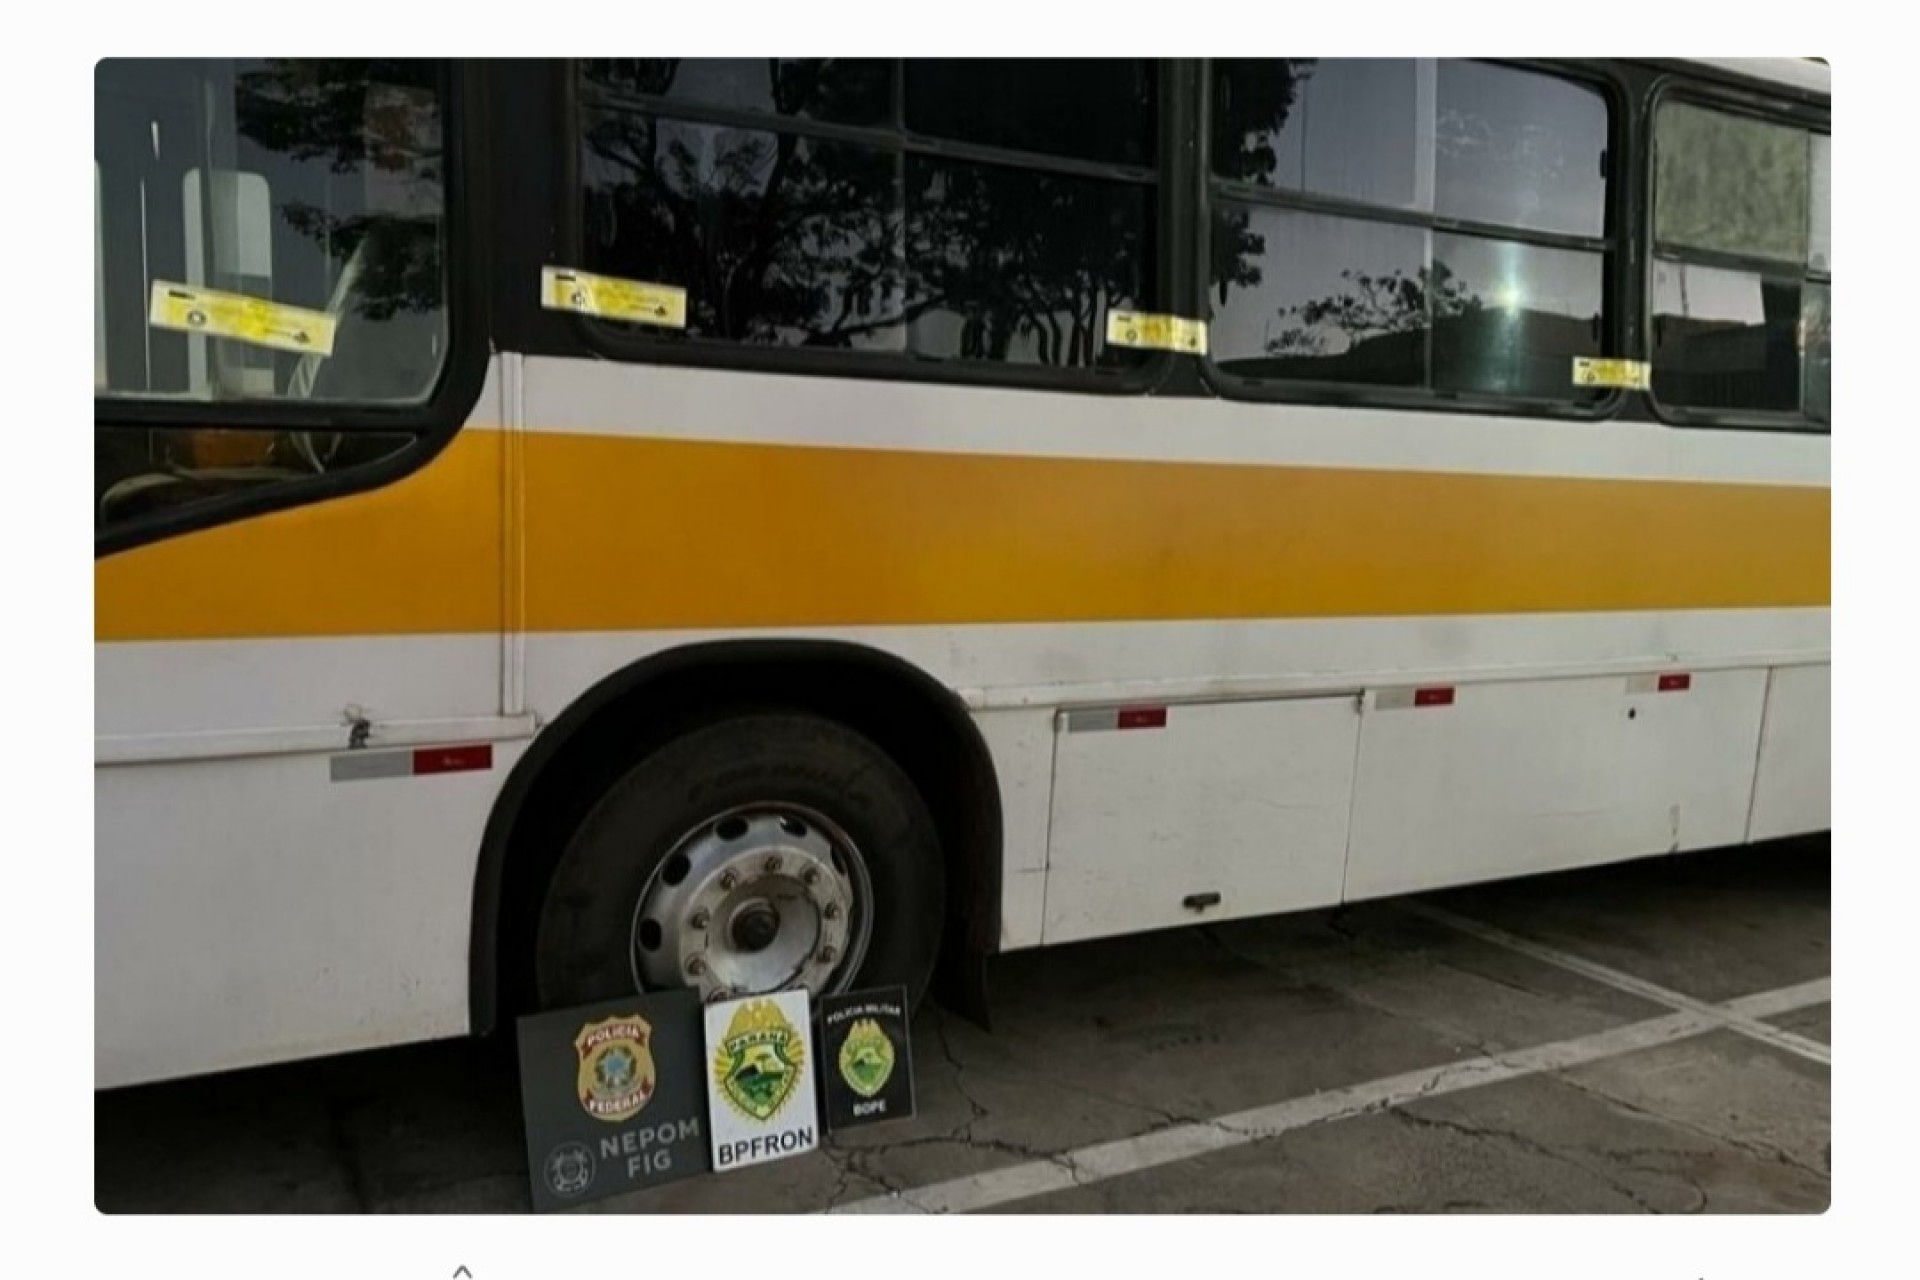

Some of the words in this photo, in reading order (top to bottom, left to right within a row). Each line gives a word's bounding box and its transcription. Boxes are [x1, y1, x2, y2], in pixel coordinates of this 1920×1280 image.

[865, 1004, 900, 1016] MILITAR
[590, 1091, 650, 1112] FEDERAL
[853, 1100, 886, 1116] BOPE
[600, 1116, 699, 1159] NEPOM
[718, 1127, 812, 1165] BPFRON
[627, 1149, 672, 1178] FIG
